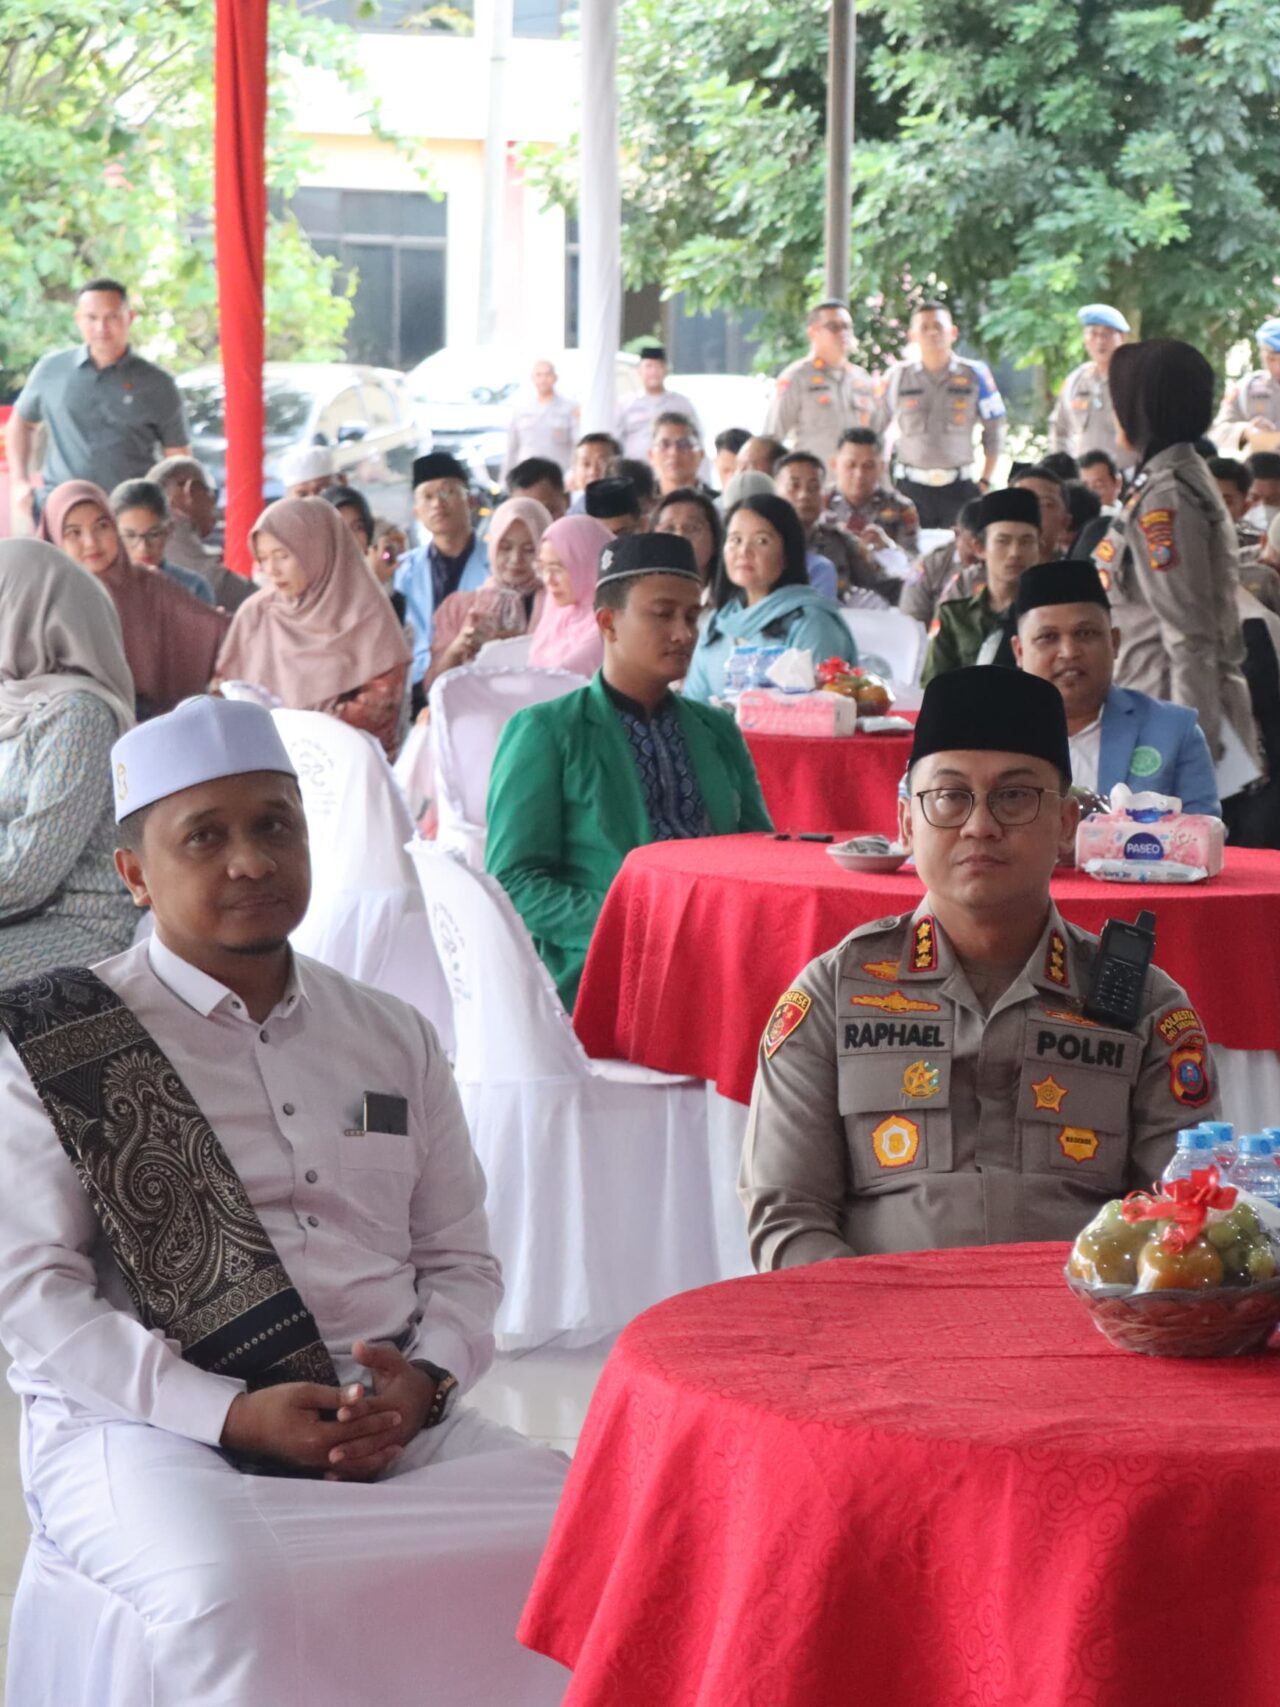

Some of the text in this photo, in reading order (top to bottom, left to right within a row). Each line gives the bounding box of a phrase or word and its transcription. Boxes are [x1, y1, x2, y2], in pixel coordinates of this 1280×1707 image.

[1126, 843, 1160, 855] PASEO
[844, 1022, 945, 1049] RAPHAEL
[1036, 1030, 1126, 1069] POLRI
